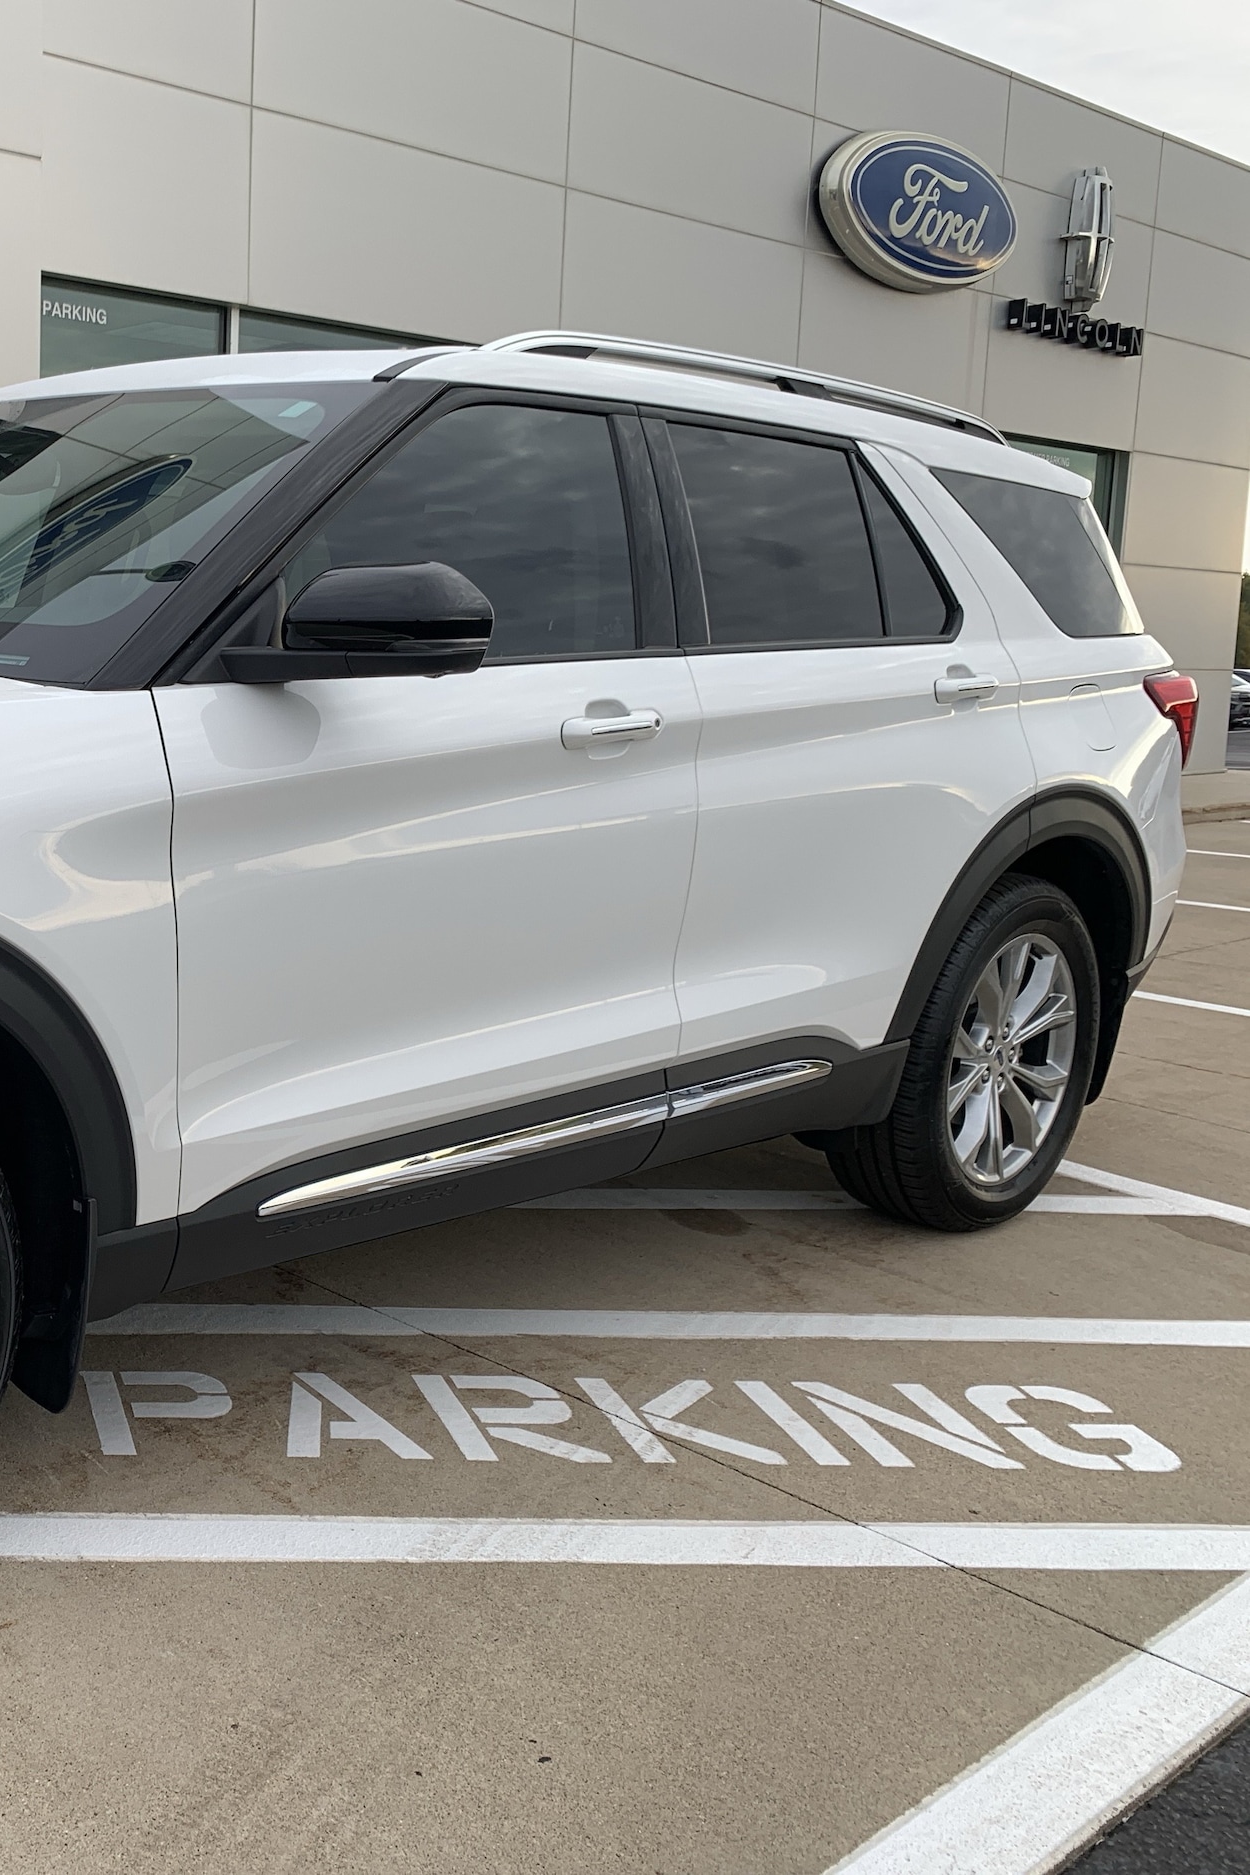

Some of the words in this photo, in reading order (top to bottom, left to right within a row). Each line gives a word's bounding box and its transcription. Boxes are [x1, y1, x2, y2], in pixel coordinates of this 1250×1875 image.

[889, 163, 989, 257] Ford
[42, 300, 107, 325] PARKING
[1008, 298, 1144, 356] LINCOLN
[85, 1370, 1183, 1473] PARKING
